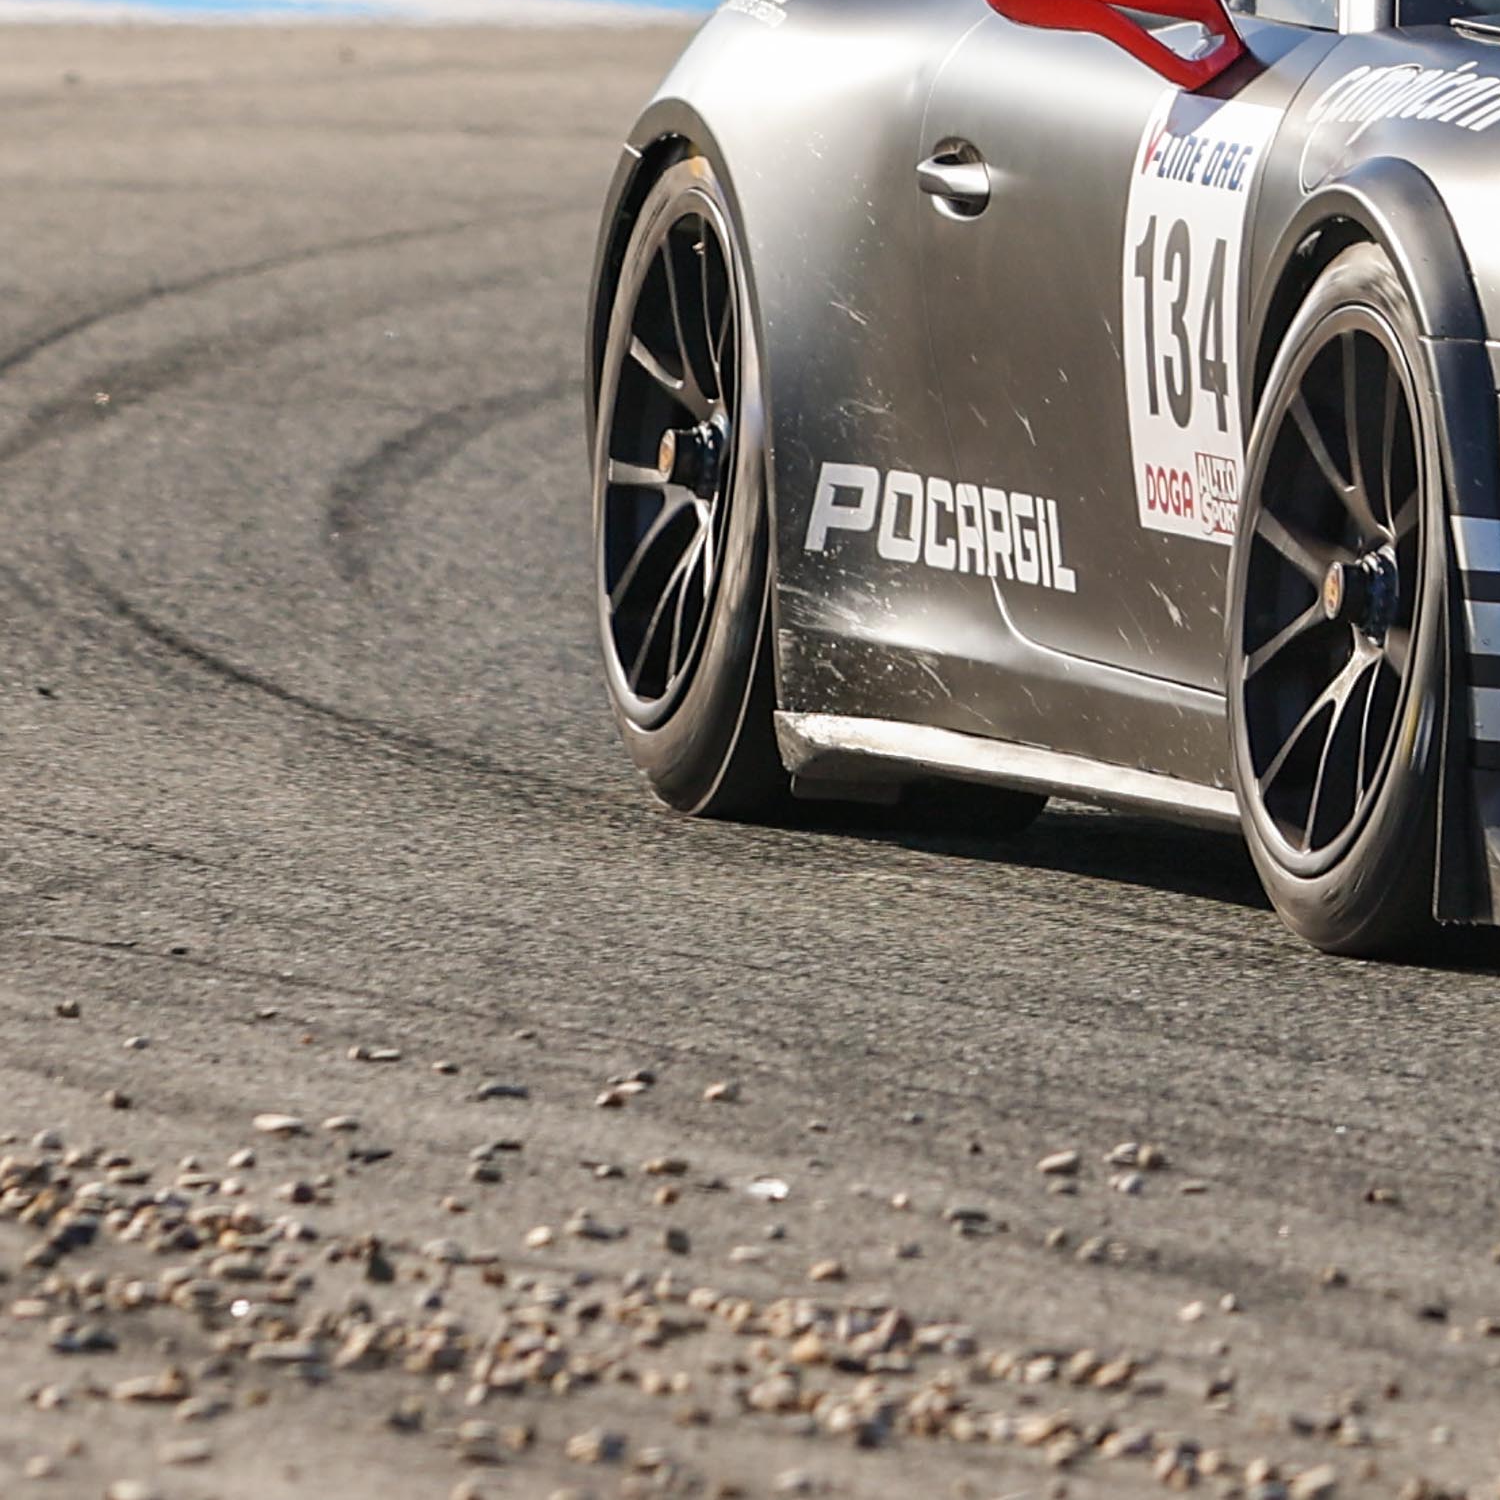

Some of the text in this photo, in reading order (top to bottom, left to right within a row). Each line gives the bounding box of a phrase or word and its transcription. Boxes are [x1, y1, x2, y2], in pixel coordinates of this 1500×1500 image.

[1134, 214, 1229, 434] 134
[1145, 463, 1195, 519] DOGA
[1198, 453, 1239, 505] AUTO
[804, 461, 1078, 594] POCARGIL
